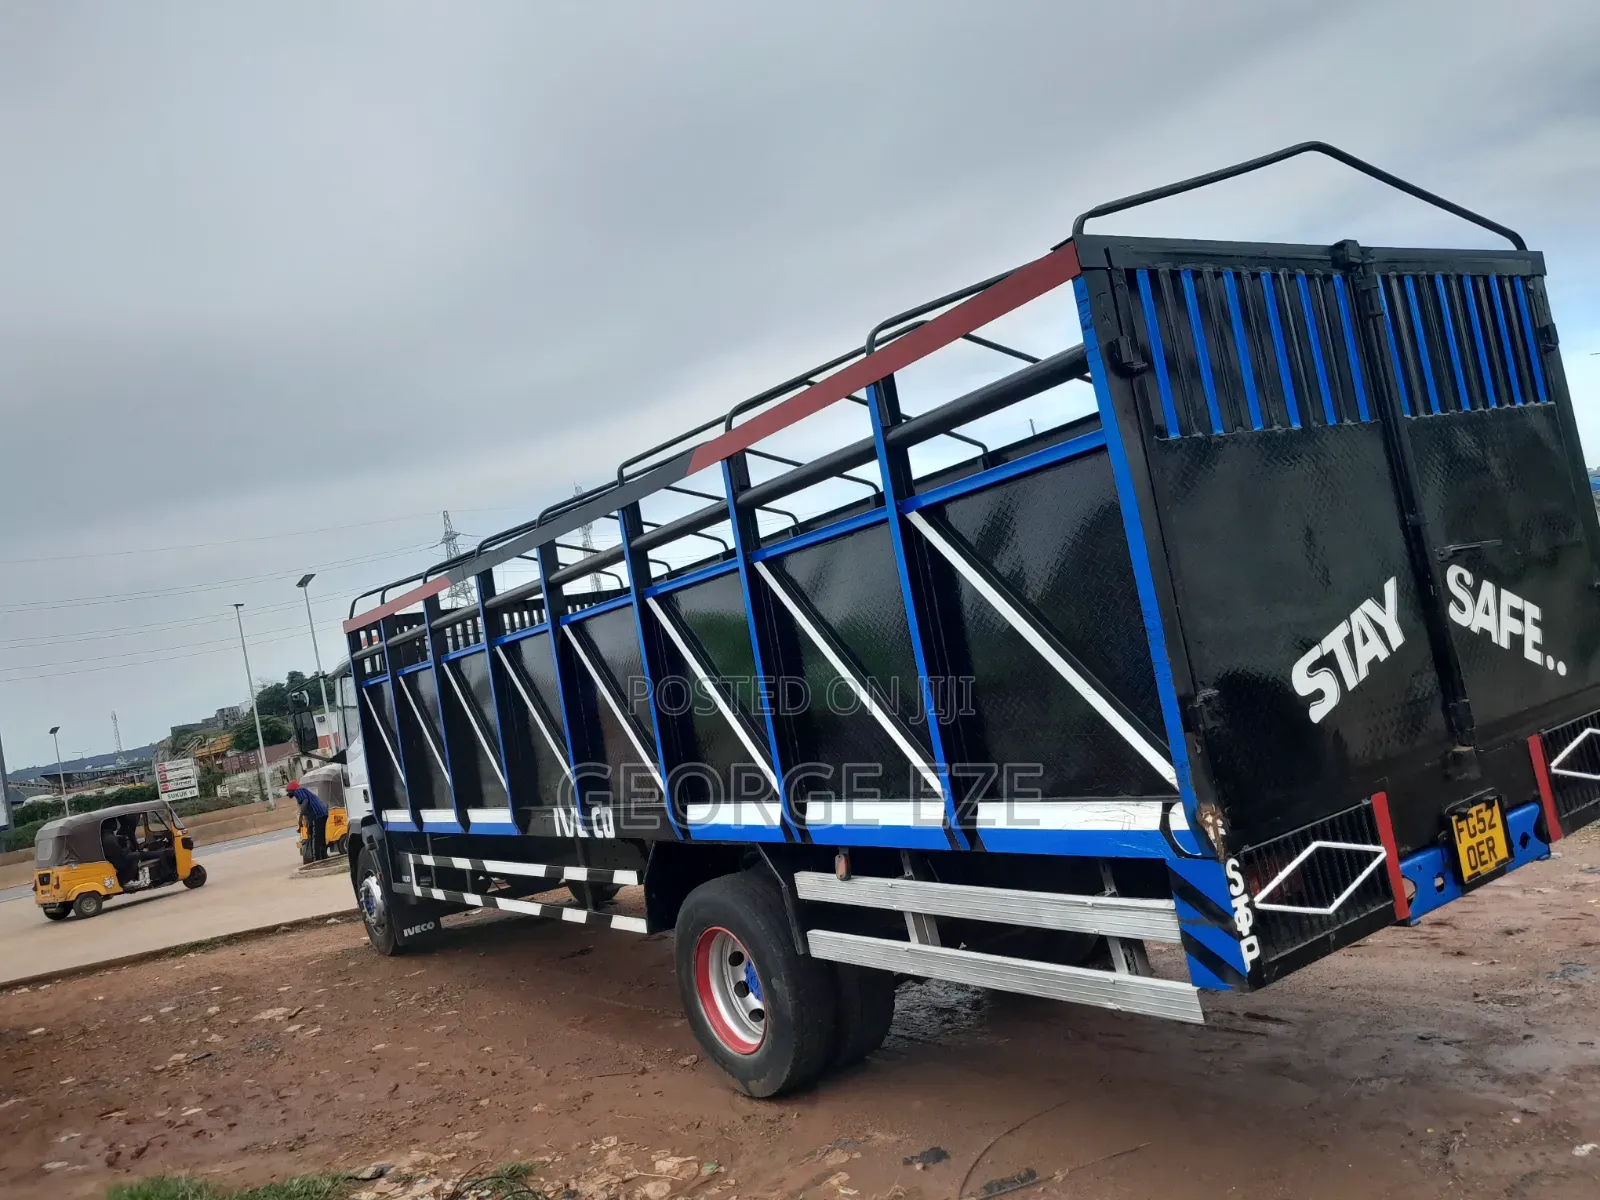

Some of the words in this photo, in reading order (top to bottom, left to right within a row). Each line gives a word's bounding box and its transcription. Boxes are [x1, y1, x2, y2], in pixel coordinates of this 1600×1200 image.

[1291, 576, 1406, 724] STAY
[1455, 806, 1497, 844] FG52
[1466, 836, 1498, 871] OER
[403, 921, 435, 937] IVECO
